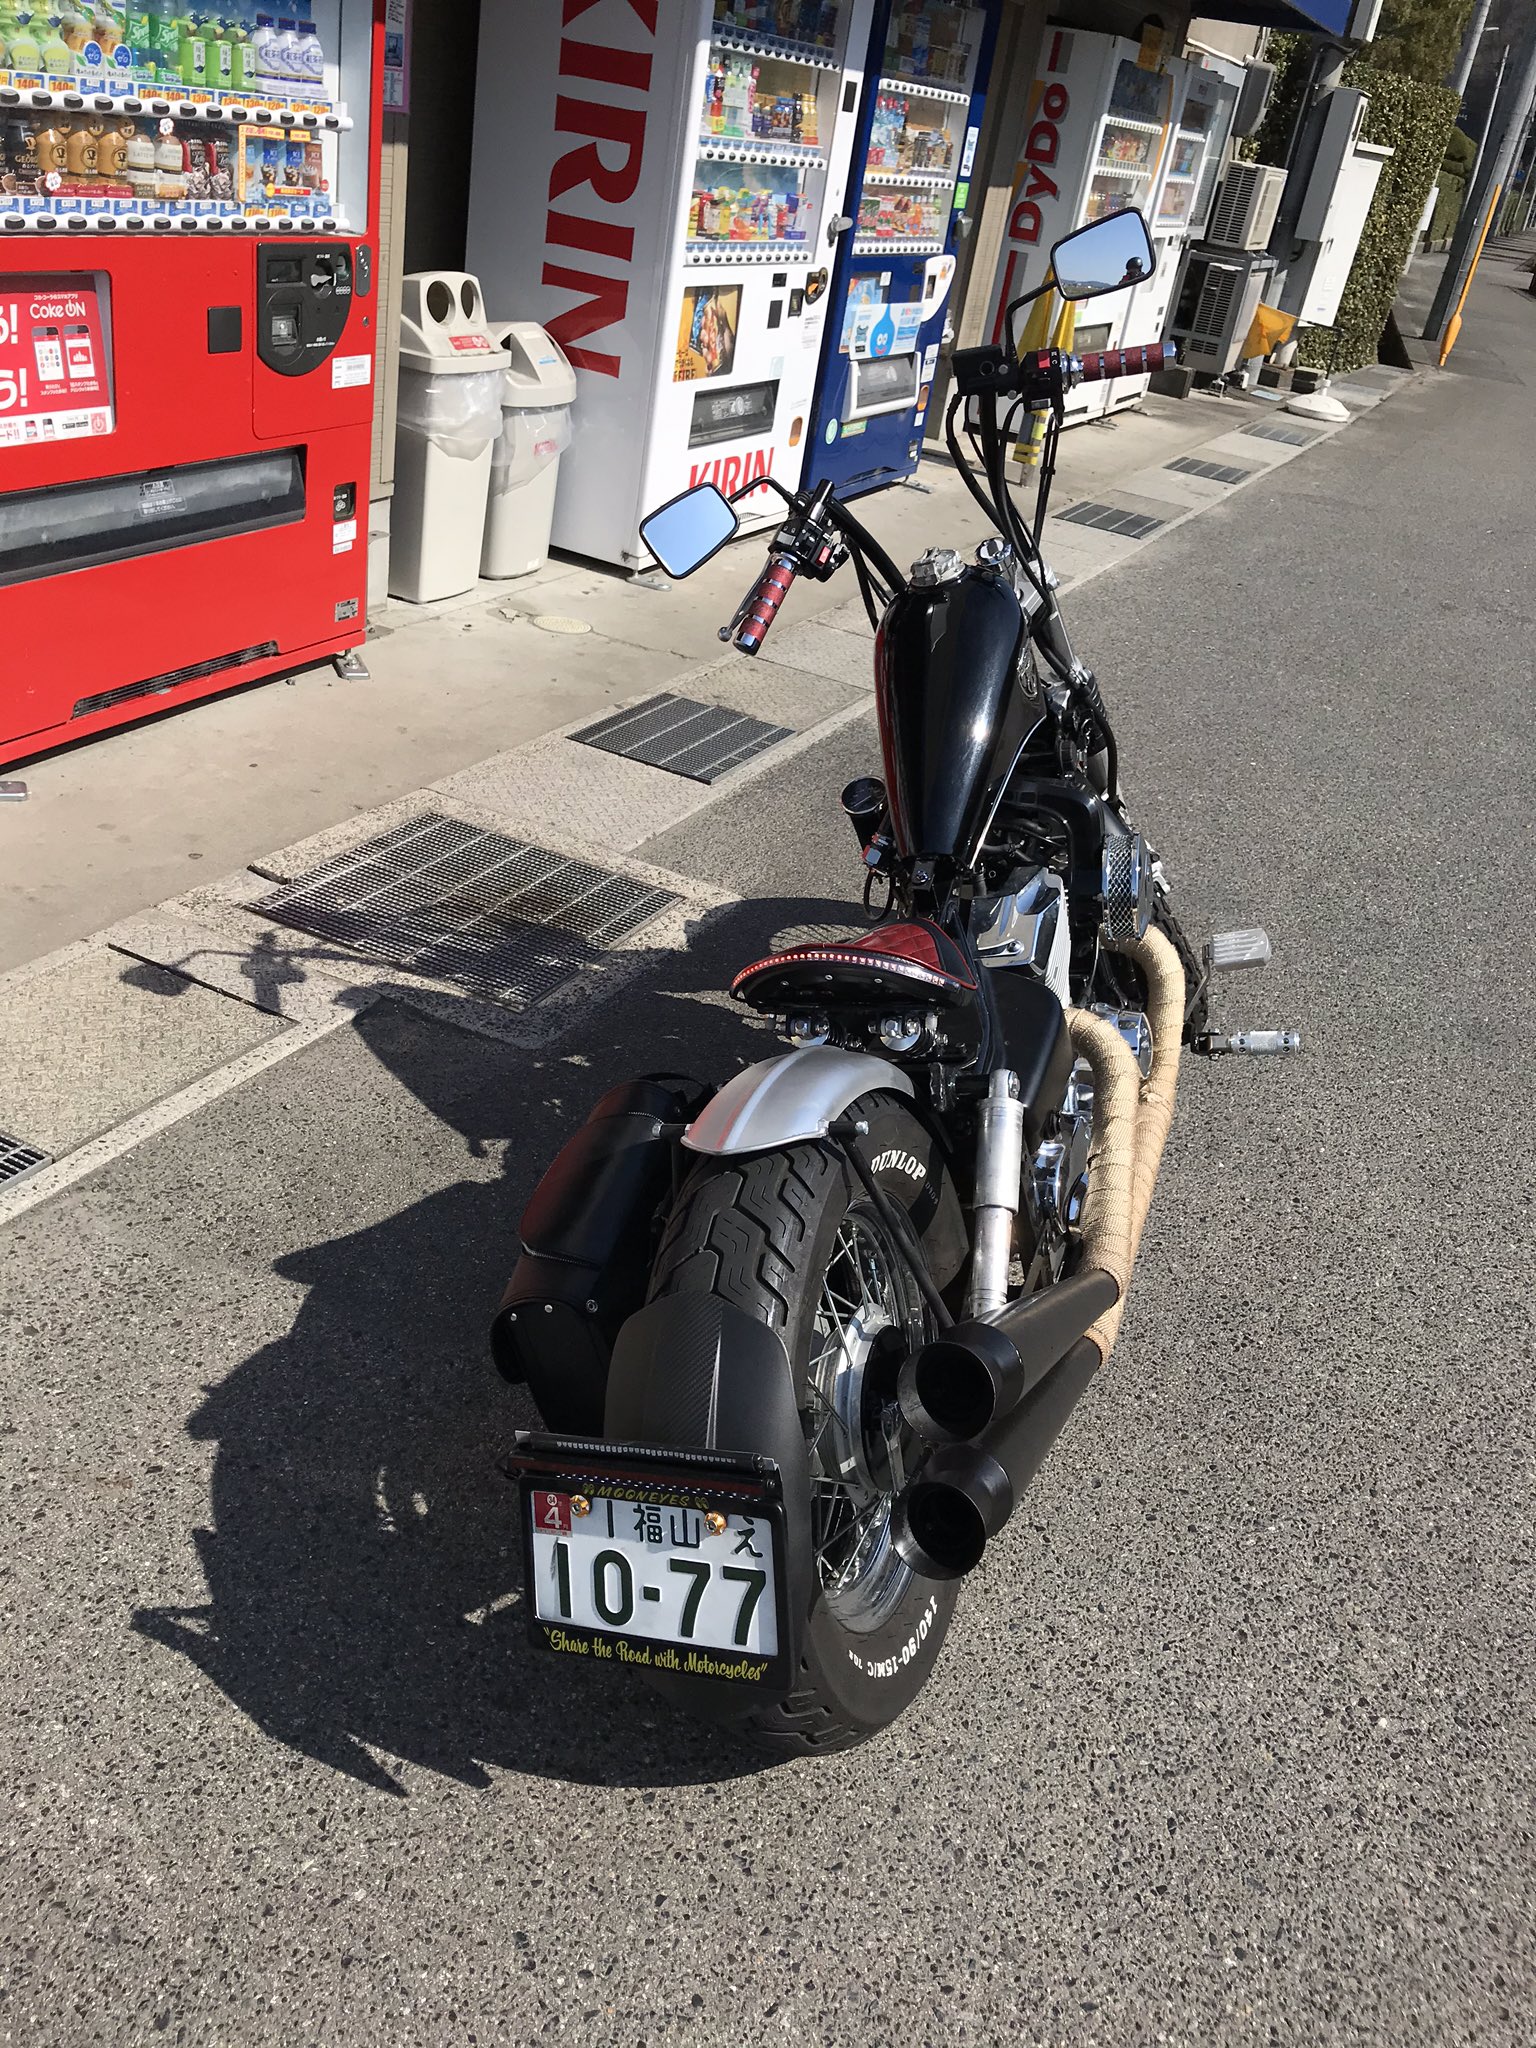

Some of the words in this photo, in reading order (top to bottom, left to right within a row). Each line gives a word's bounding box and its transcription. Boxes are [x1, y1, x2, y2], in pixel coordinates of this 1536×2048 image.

[30, 303, 64, 319] Coke
[65, 299, 86, 317] ON
[871, 1150, 926, 1180] DUNLOP
[597, 1486, 690, 1507] MOONEYES
[556, 1541, 767, 1647] 10-77
[591, 1637, 612, 1658] the
[616, 1641, 652, 1665] Road
[654, 1649, 681, 1671] with
